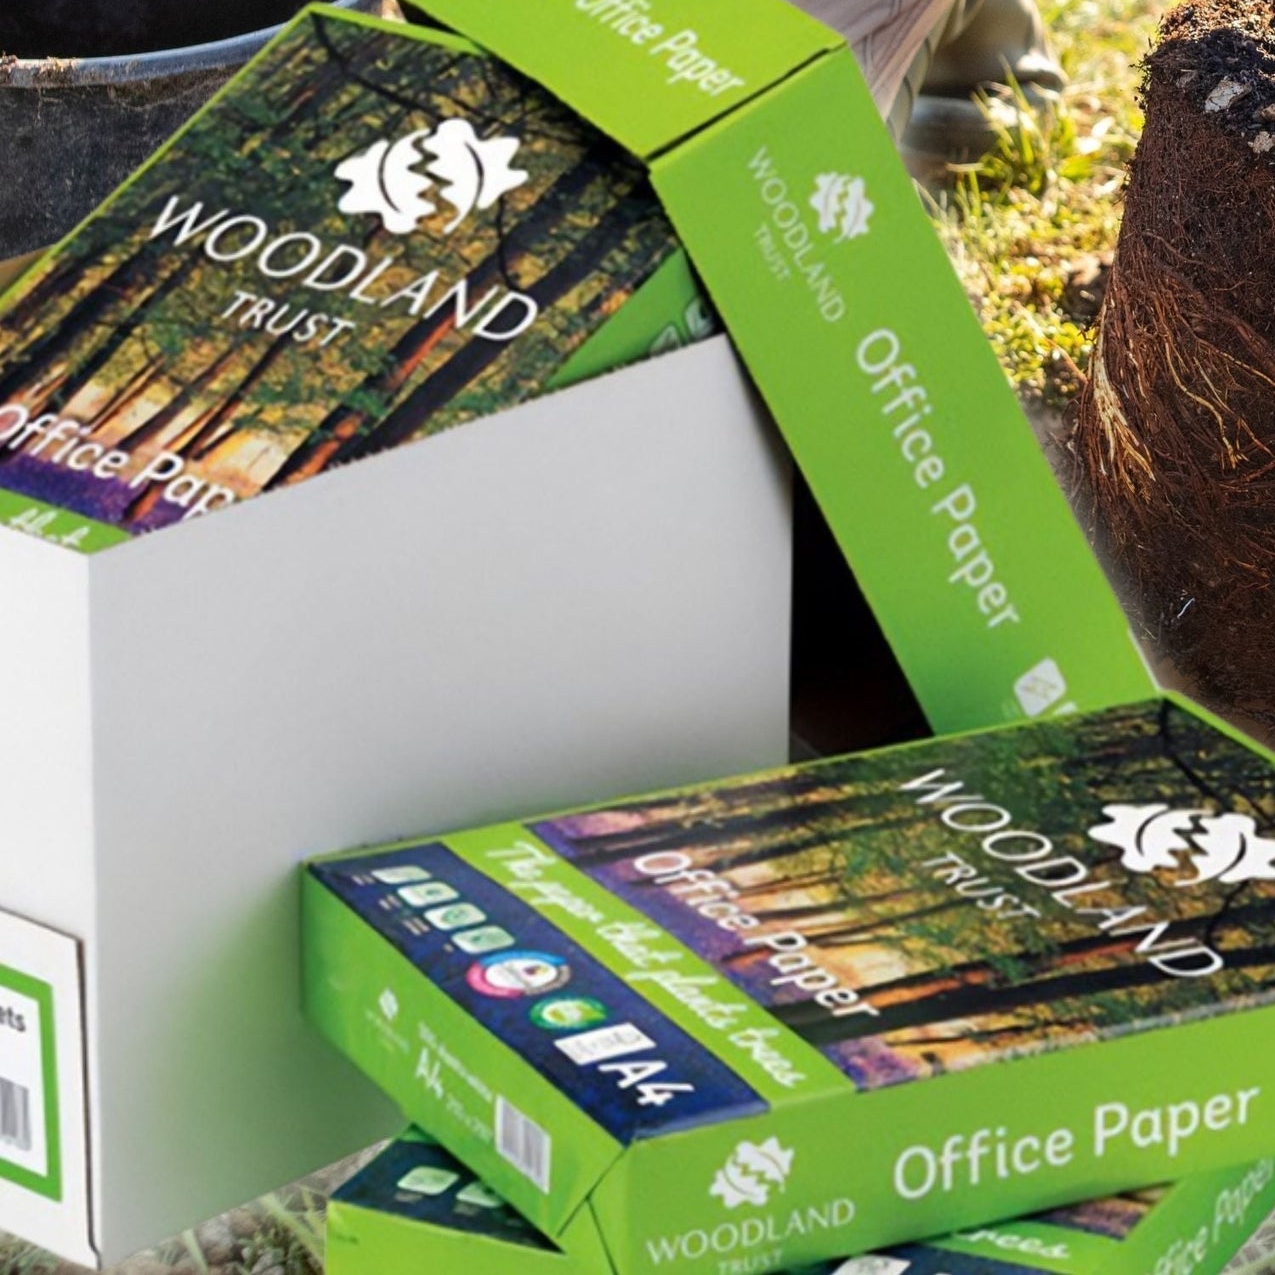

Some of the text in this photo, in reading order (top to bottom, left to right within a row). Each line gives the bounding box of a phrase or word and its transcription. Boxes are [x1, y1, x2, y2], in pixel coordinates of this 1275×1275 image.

[650, 28, 745, 97] Paper
[748, 146, 846, 323] WOODLAND
[753, 225, 793, 281] TRUST
[147, 196, 539, 343] WOODLAND
[221, 290, 357, 348] TRUST
[0, 404, 130, 479] Office
[855, 327, 1020, 629] Office Paper
[899, 768, 1223, 977] WOODLAND
[922, 852, 1041, 920] TRUST
[596, 921, 684, 967] that
[633, 851, 880, 1019] Office Paper
[625, 970, 747, 1030] plants
[597, 1060, 695, 1107] A4
[728, 1028, 806, 1088] trees
[893, 1086, 1261, 1200] Office Paper
[646, 1198, 856, 1266] WOODLAND
[952, 1229, 1072, 1260] rees
